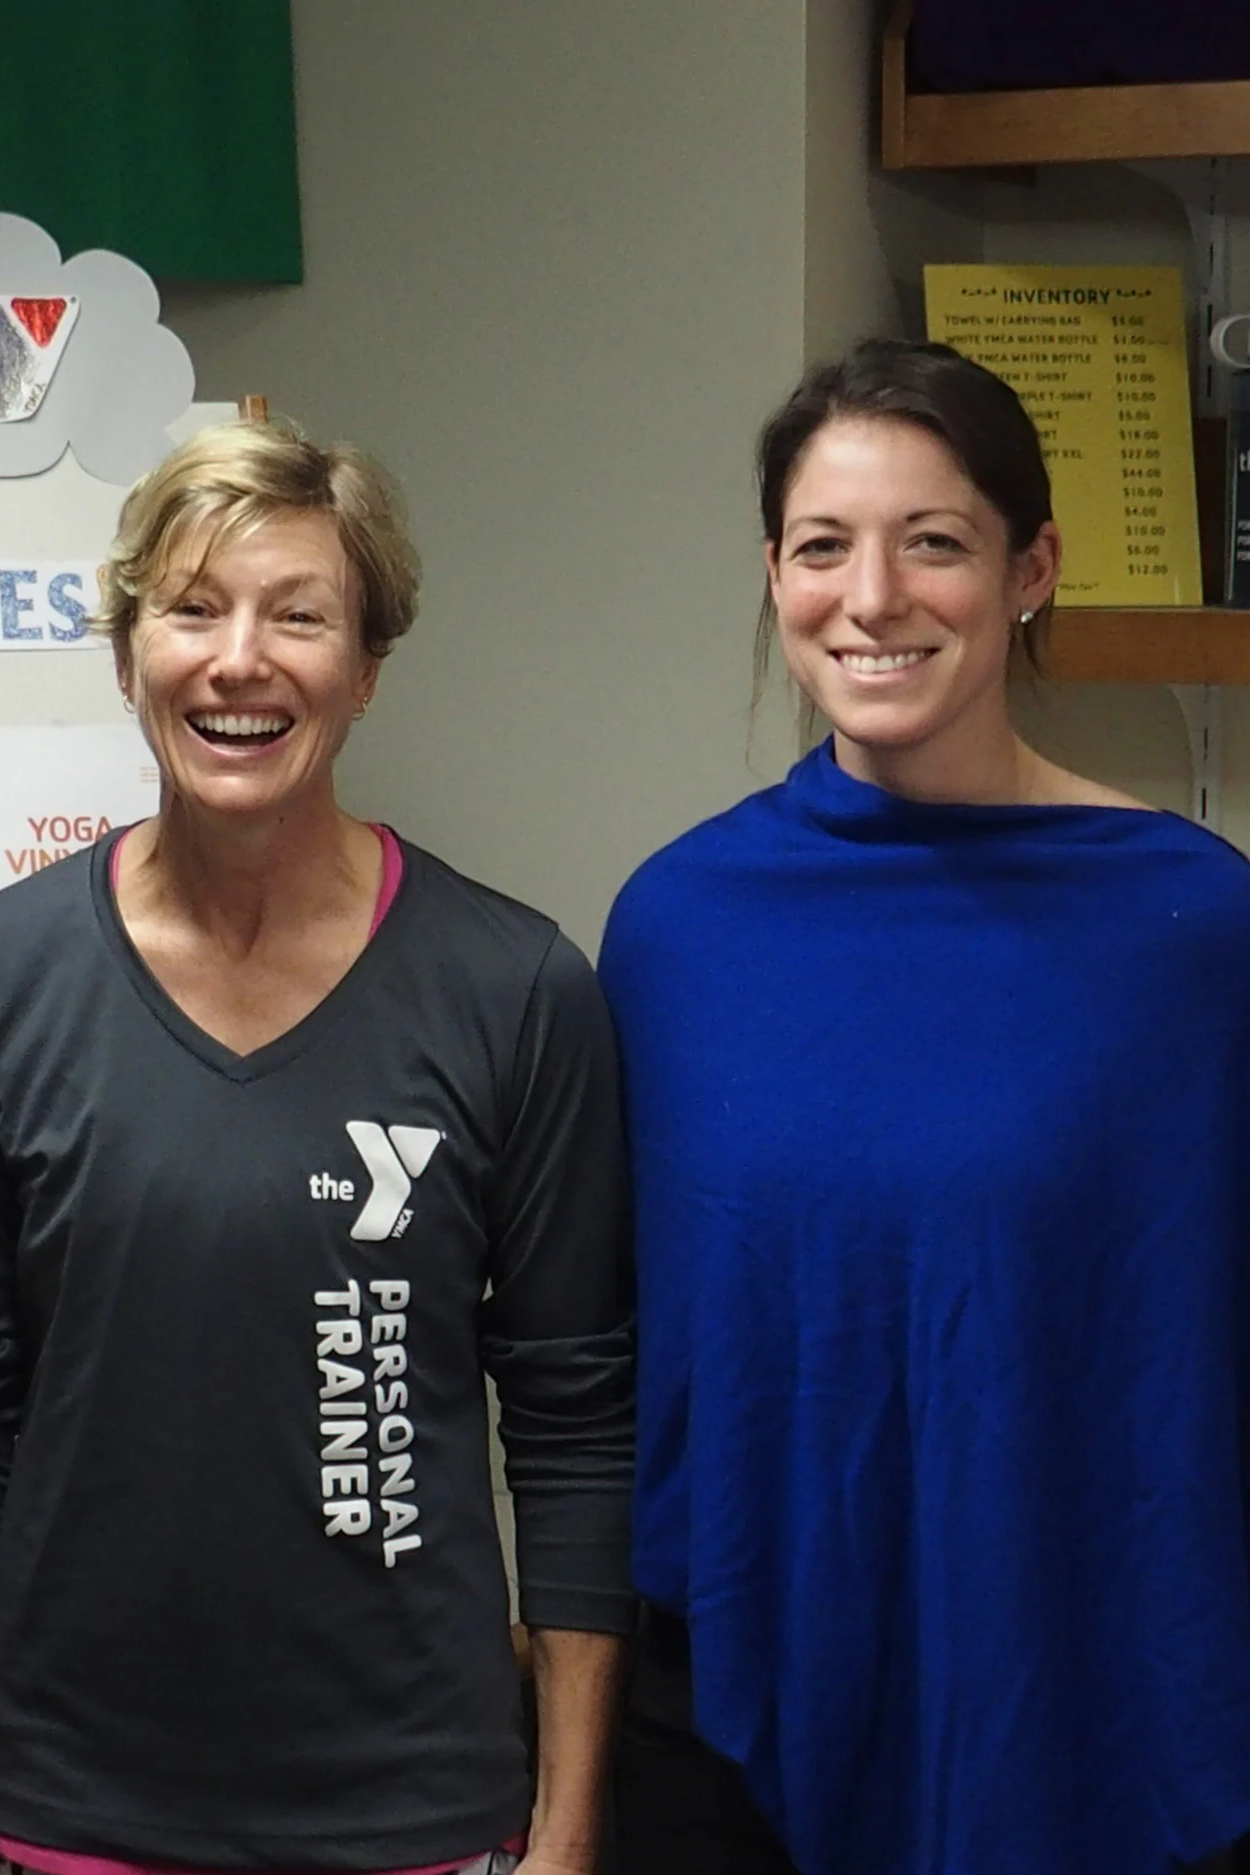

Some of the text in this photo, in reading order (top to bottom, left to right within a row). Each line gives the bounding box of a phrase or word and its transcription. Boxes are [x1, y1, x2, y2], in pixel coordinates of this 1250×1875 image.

[1003, 288, 1110, 305] INVENTORY
[945, 315, 981, 325] TOWEL
[1017, 334, 1054, 344] WATER
[1058, 333, 1098, 345] BOTTLE
[1011, 354, 1048, 363] WATER
[1051, 354, 1091, 364] BOTTLE
[27, 816, 114, 843] YOGA
[5, 849, 77, 875] VIN
[309, 1173, 354, 1201] the
[390, 1207, 415, 1239] YMCA
[314, 1279, 372, 1537] TRAINER
[369, 1280, 422, 1568] PERSONAL
